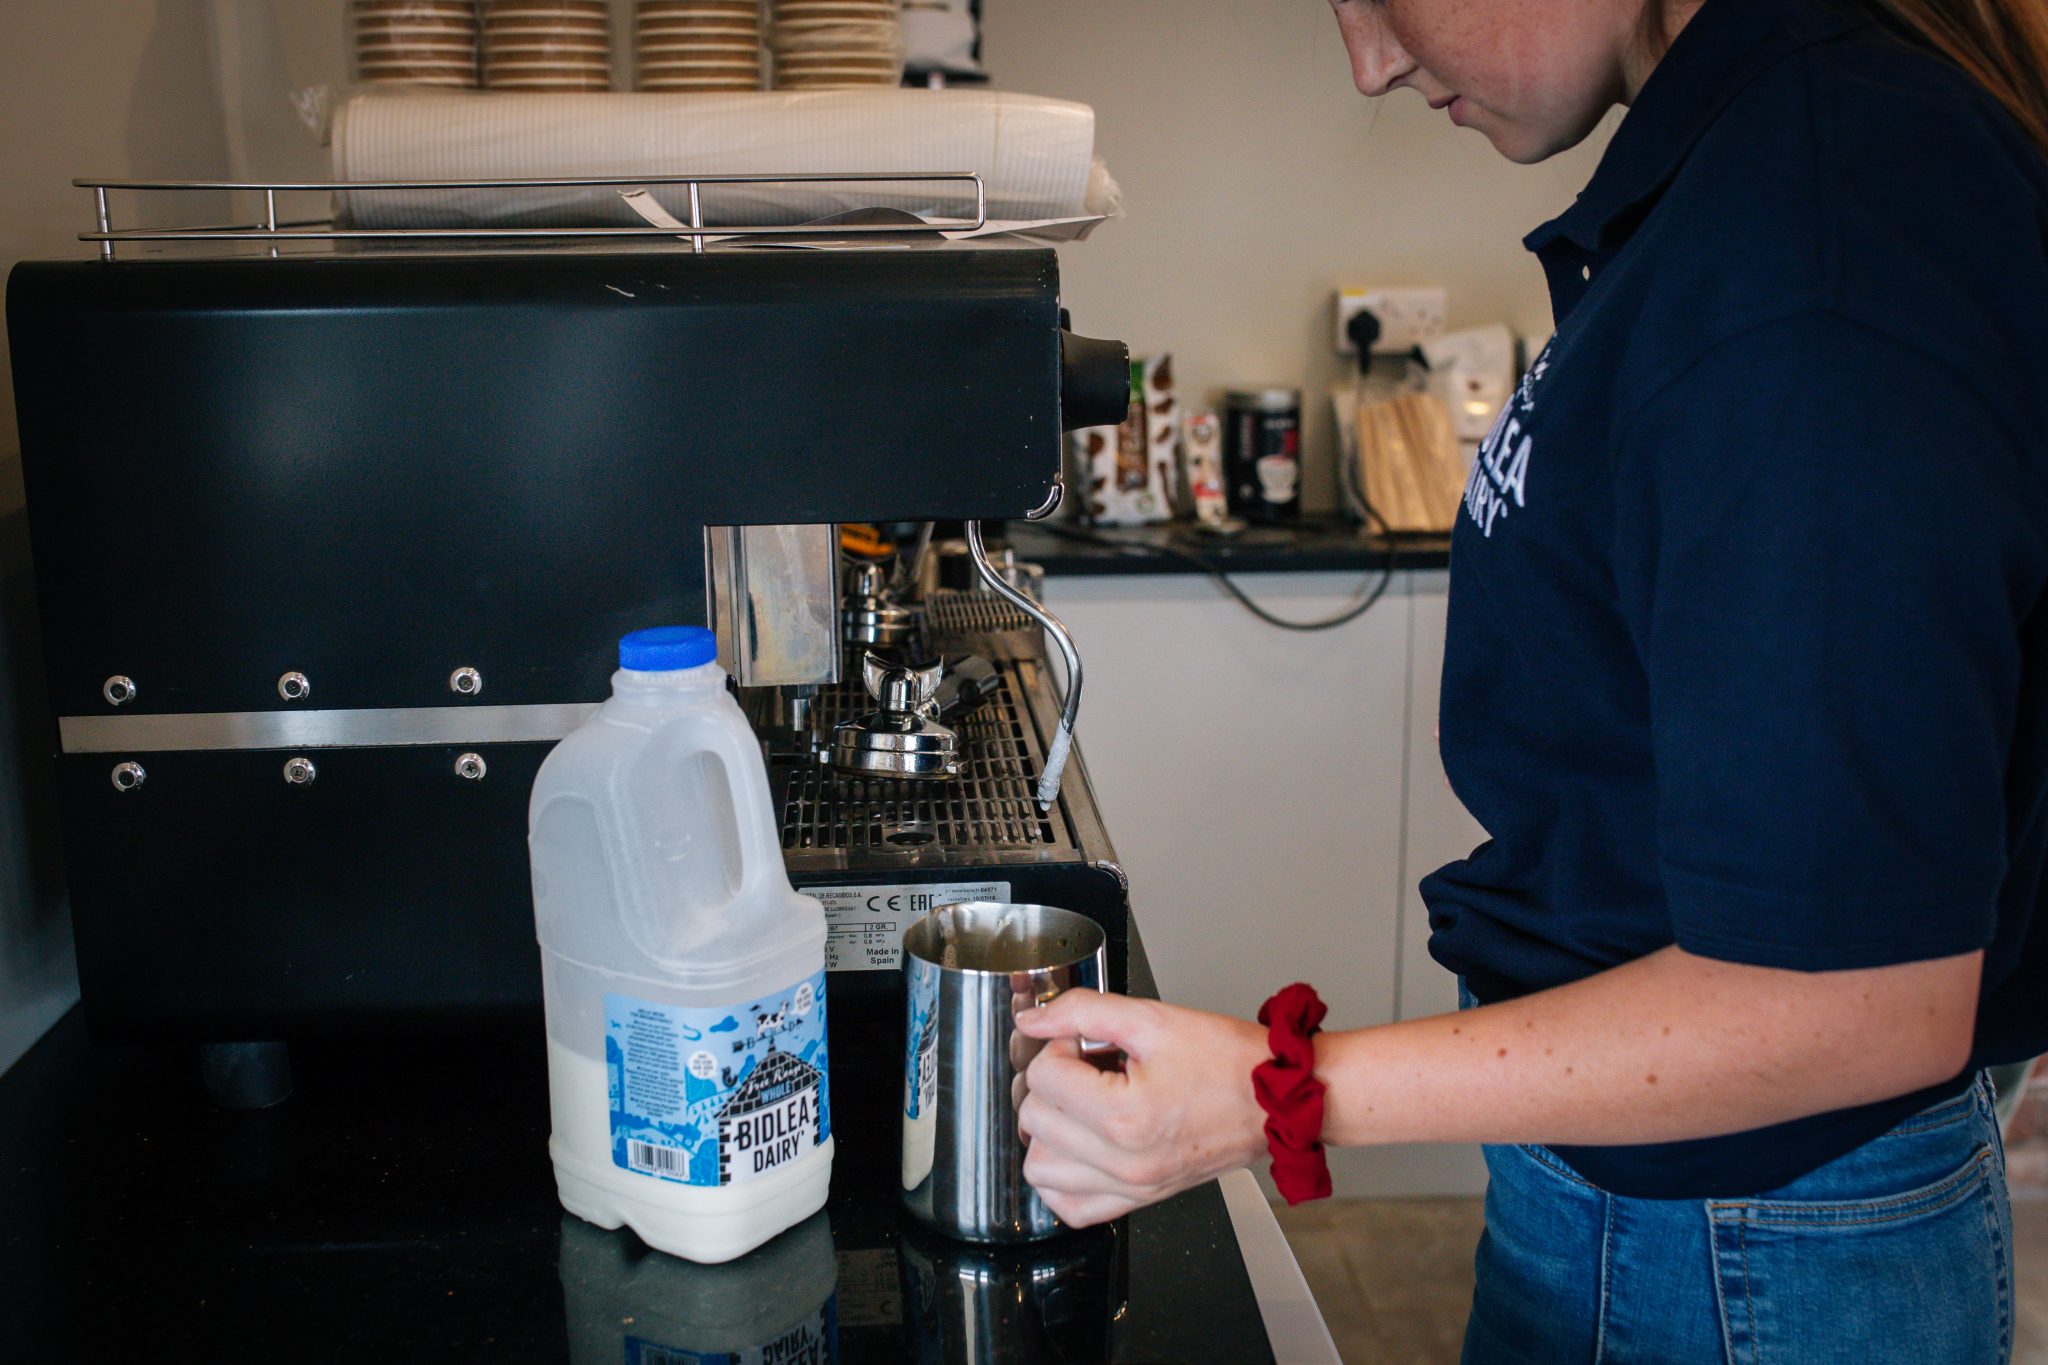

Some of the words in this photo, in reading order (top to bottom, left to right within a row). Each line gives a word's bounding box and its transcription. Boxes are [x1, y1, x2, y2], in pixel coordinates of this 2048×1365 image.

[870, 956, 894, 966] Spain
[891, 947, 899, 955] in
[734, 1095, 811, 1150] BIDLEA
[753, 1137, 800, 1173] DAIRY
